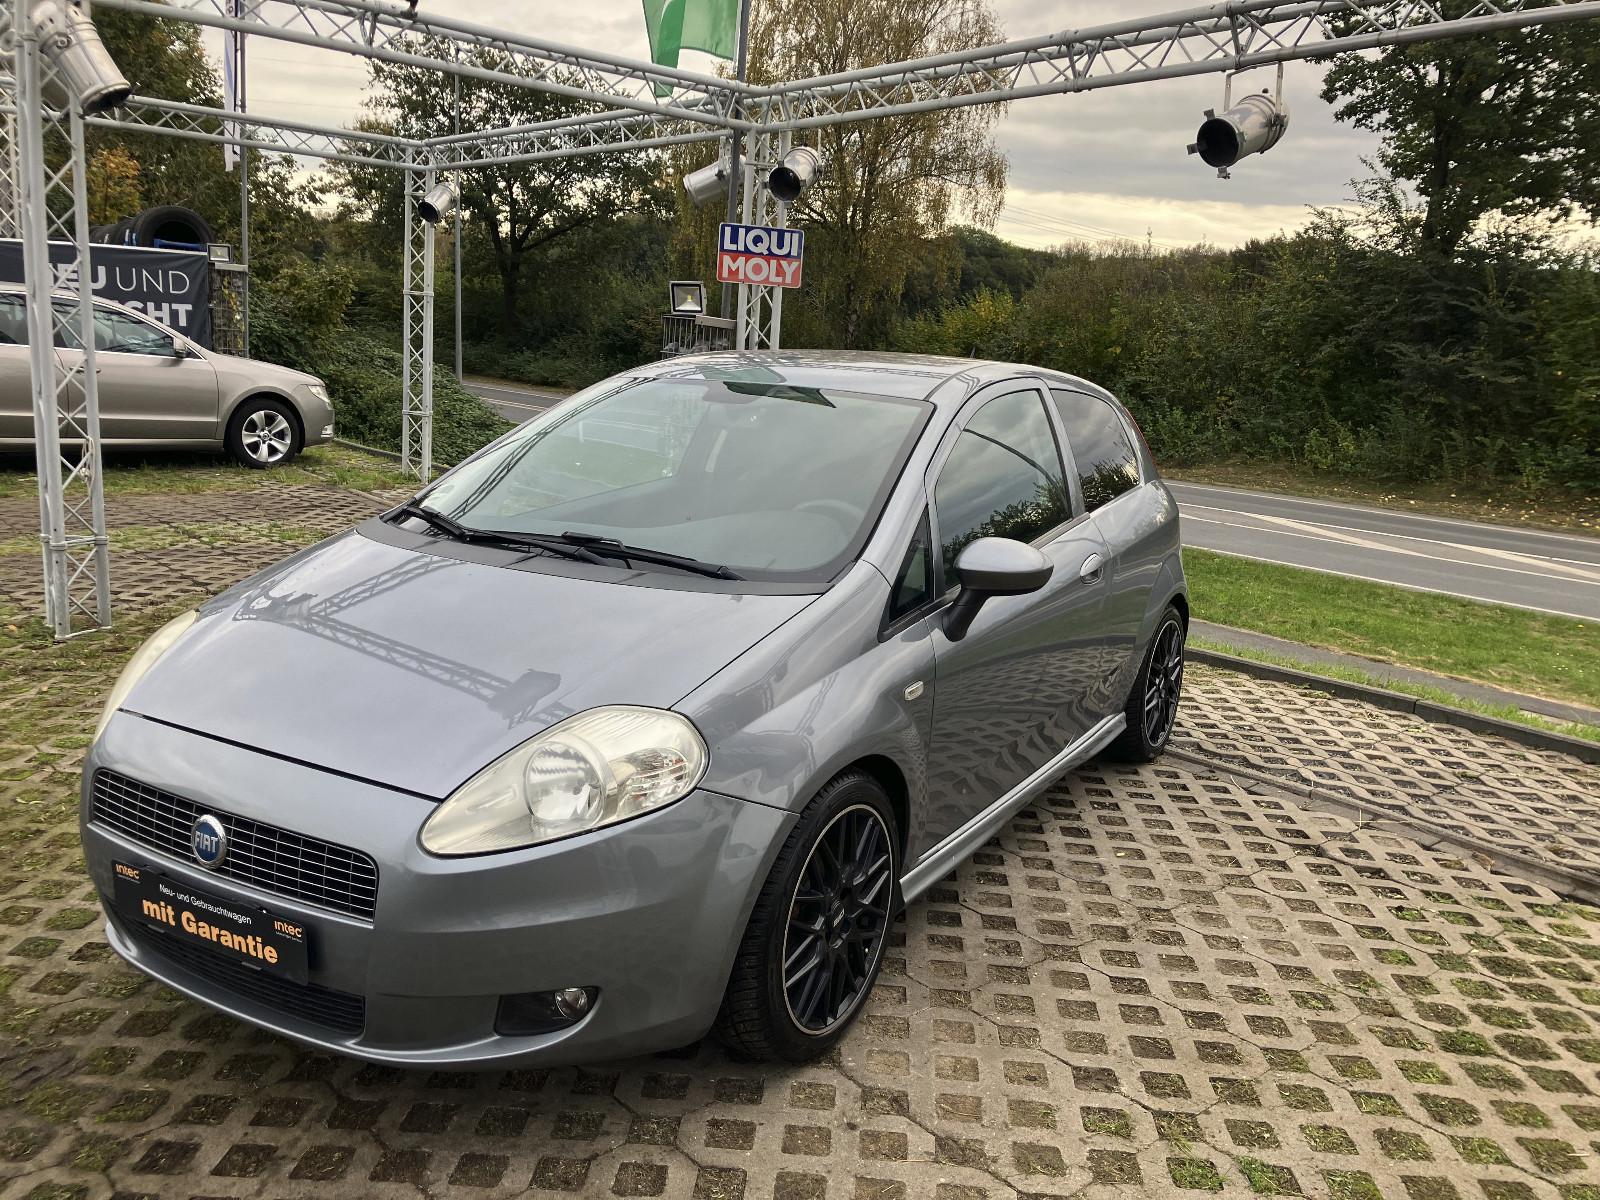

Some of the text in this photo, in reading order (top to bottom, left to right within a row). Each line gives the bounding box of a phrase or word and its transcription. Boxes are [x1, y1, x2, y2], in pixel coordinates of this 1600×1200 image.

[723, 226, 799, 256] LIQUI
[115, 266, 190, 294] UND
[722, 255, 801, 284] MOLY
[195, 830, 219, 853] FIAT
[176, 891, 190, 903] und
[190, 896, 252, 924] Gebrauchtwagen
[142, 899, 278, 964] mit Garantie
